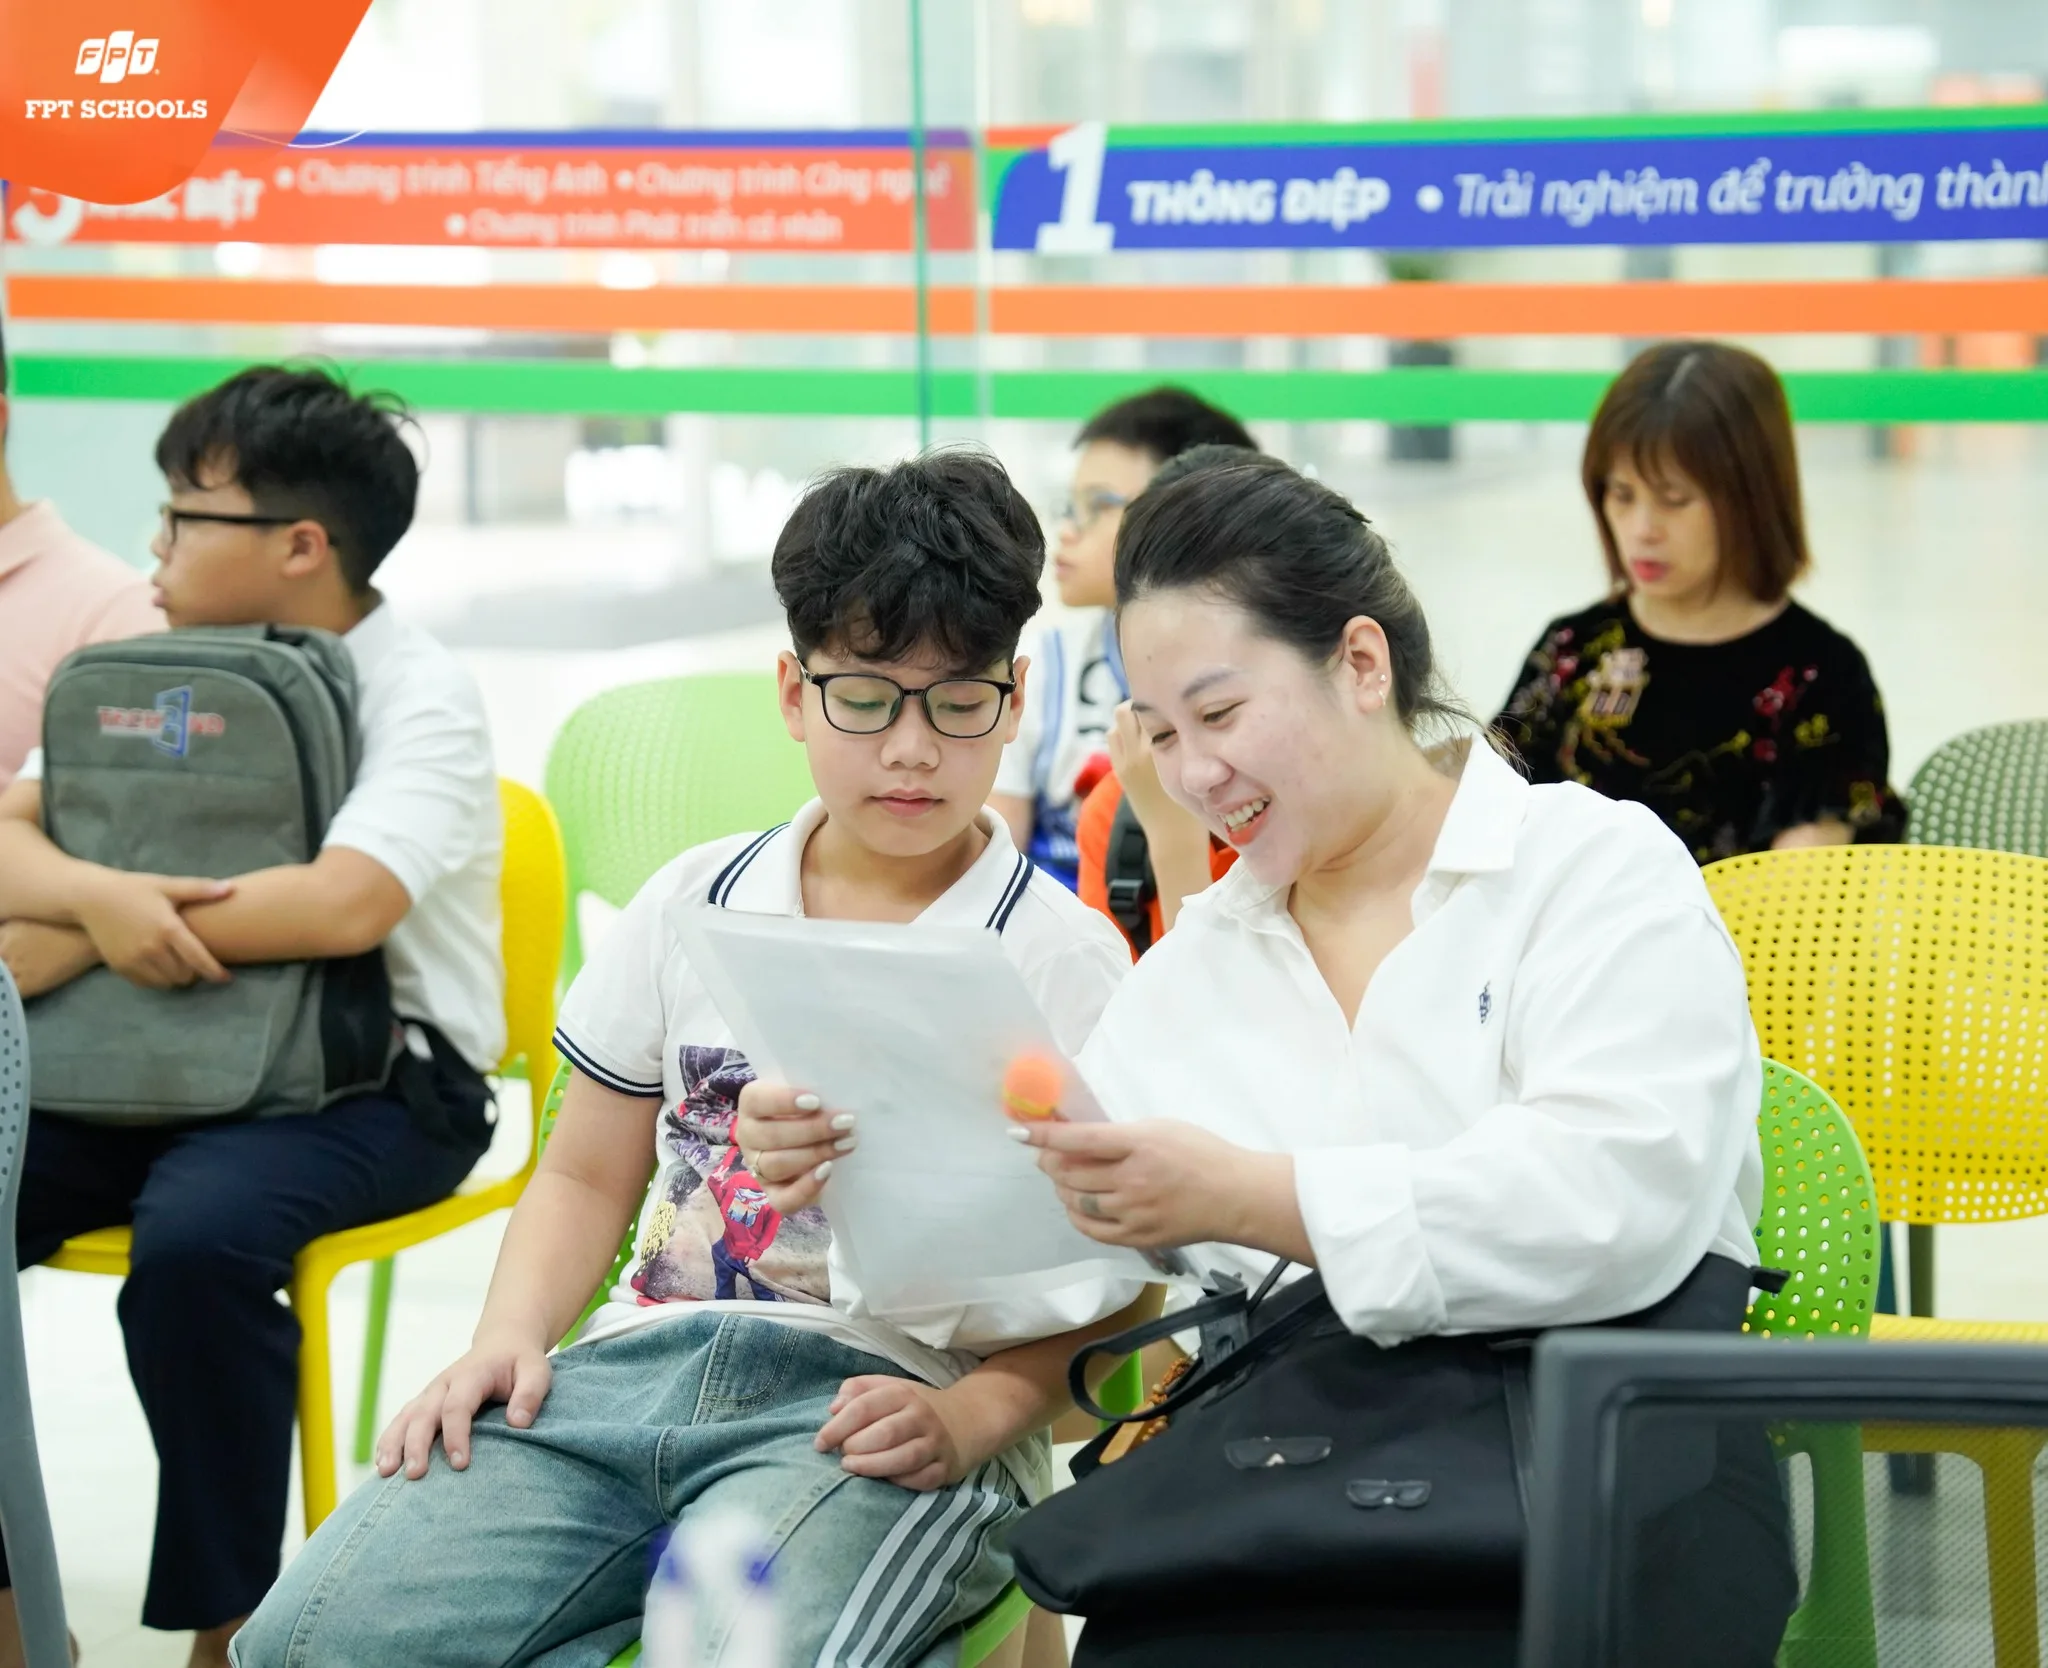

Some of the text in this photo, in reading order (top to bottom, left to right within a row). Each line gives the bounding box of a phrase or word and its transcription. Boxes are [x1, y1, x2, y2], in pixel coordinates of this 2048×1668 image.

[1034, 120, 1116, 253] 1
[1126, 167, 1391, 232] THÔNG ĐIỆP
[1453, 168, 1535, 218] Trải
[1541, 166, 1699, 228] nghiệm
[1707, 157, 1772, 214] để
